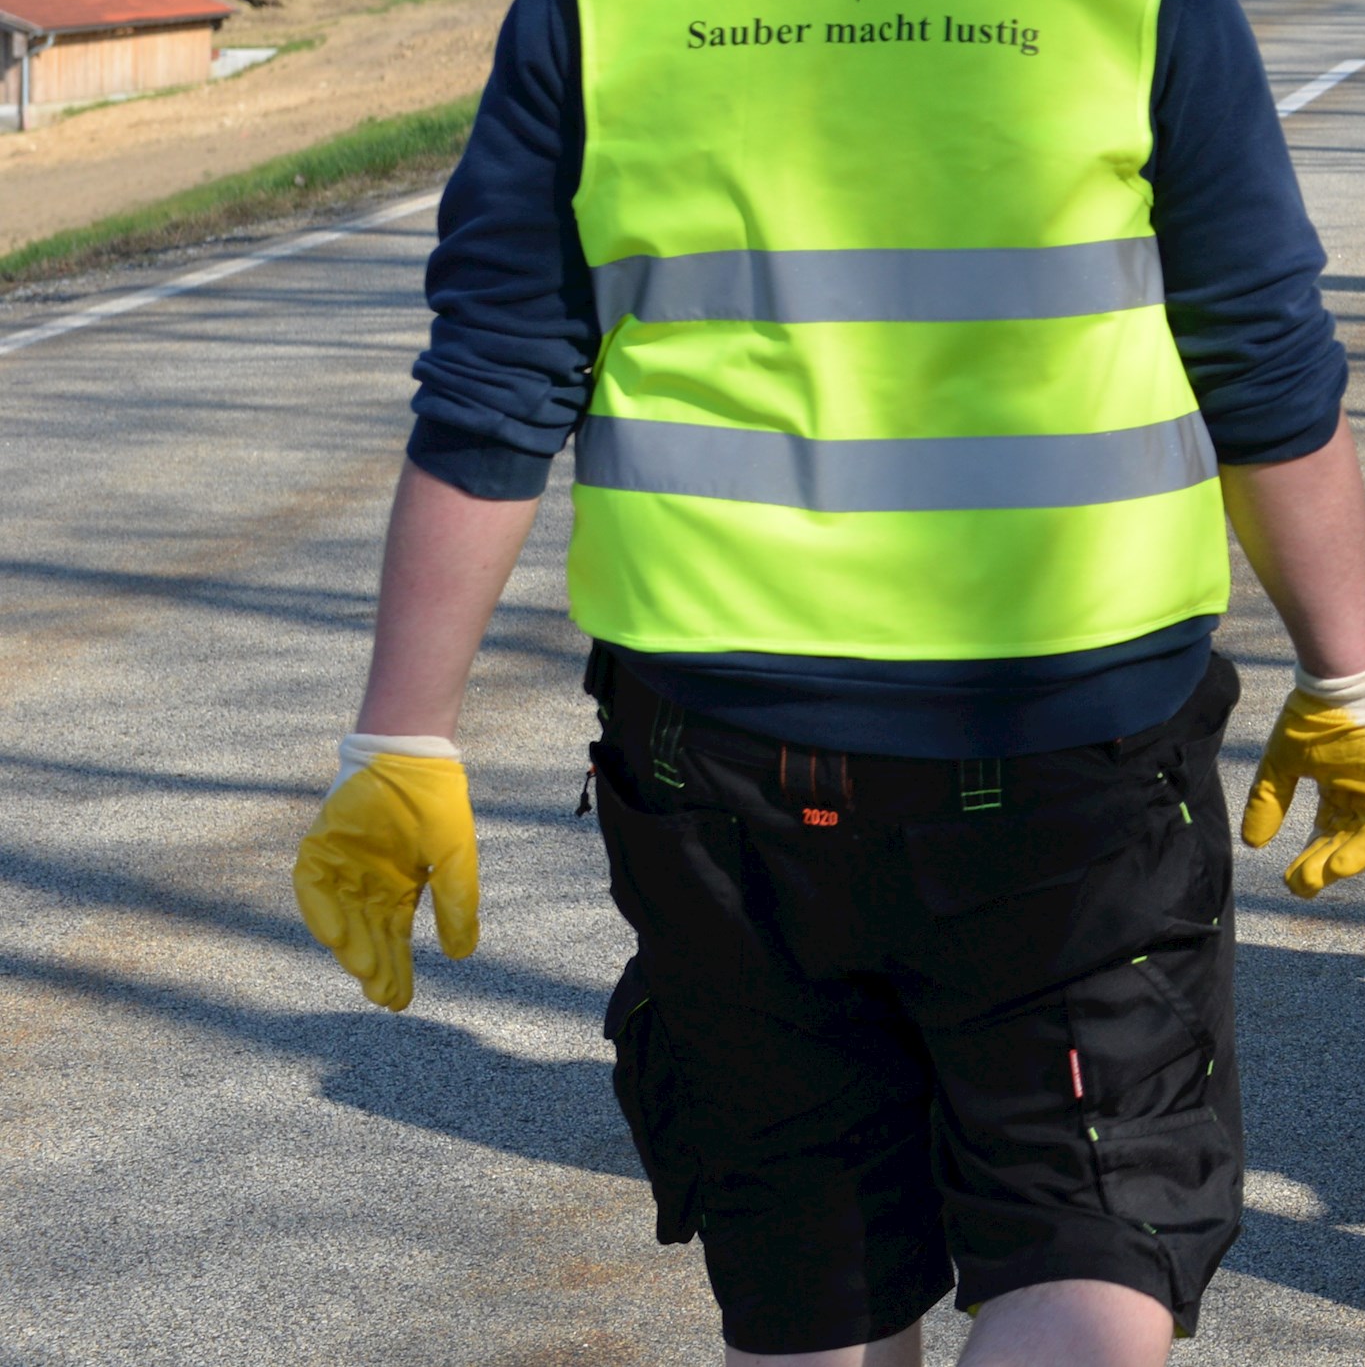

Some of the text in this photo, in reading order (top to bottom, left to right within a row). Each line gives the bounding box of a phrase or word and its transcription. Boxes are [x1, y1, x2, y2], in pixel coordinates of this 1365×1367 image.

[687, 13, 1040, 56] Sauber macht lustig
[802, 807, 839, 827] 2020
